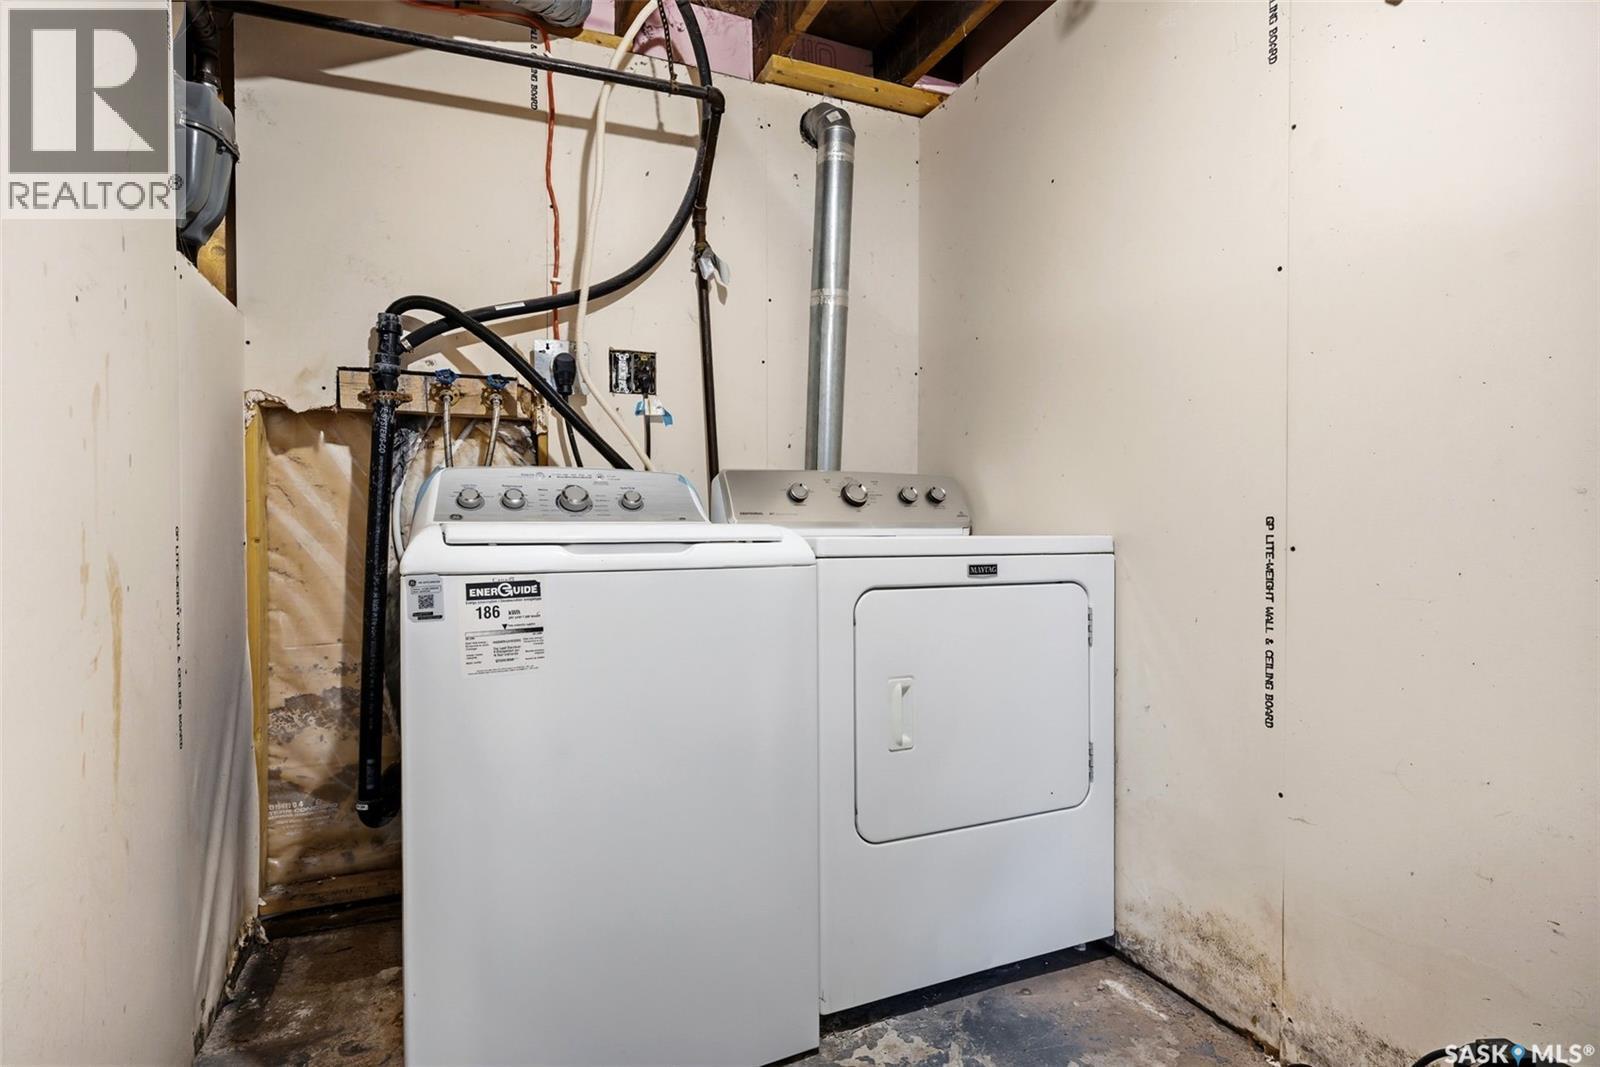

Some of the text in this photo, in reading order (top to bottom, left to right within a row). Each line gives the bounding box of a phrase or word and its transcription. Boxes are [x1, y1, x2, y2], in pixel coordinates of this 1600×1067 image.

[1267, 26, 1278, 65] BOARD
[530, 84, 538, 110] BOARD
[969, 565, 998, 575] MAYTAG
[469, 582, 539, 598] ENERGUIDE
[475, 605, 501, 620] 186
[1264, 515, 1275, 729] GP LITE-WEIGHT WALL & CEILING BOARD
